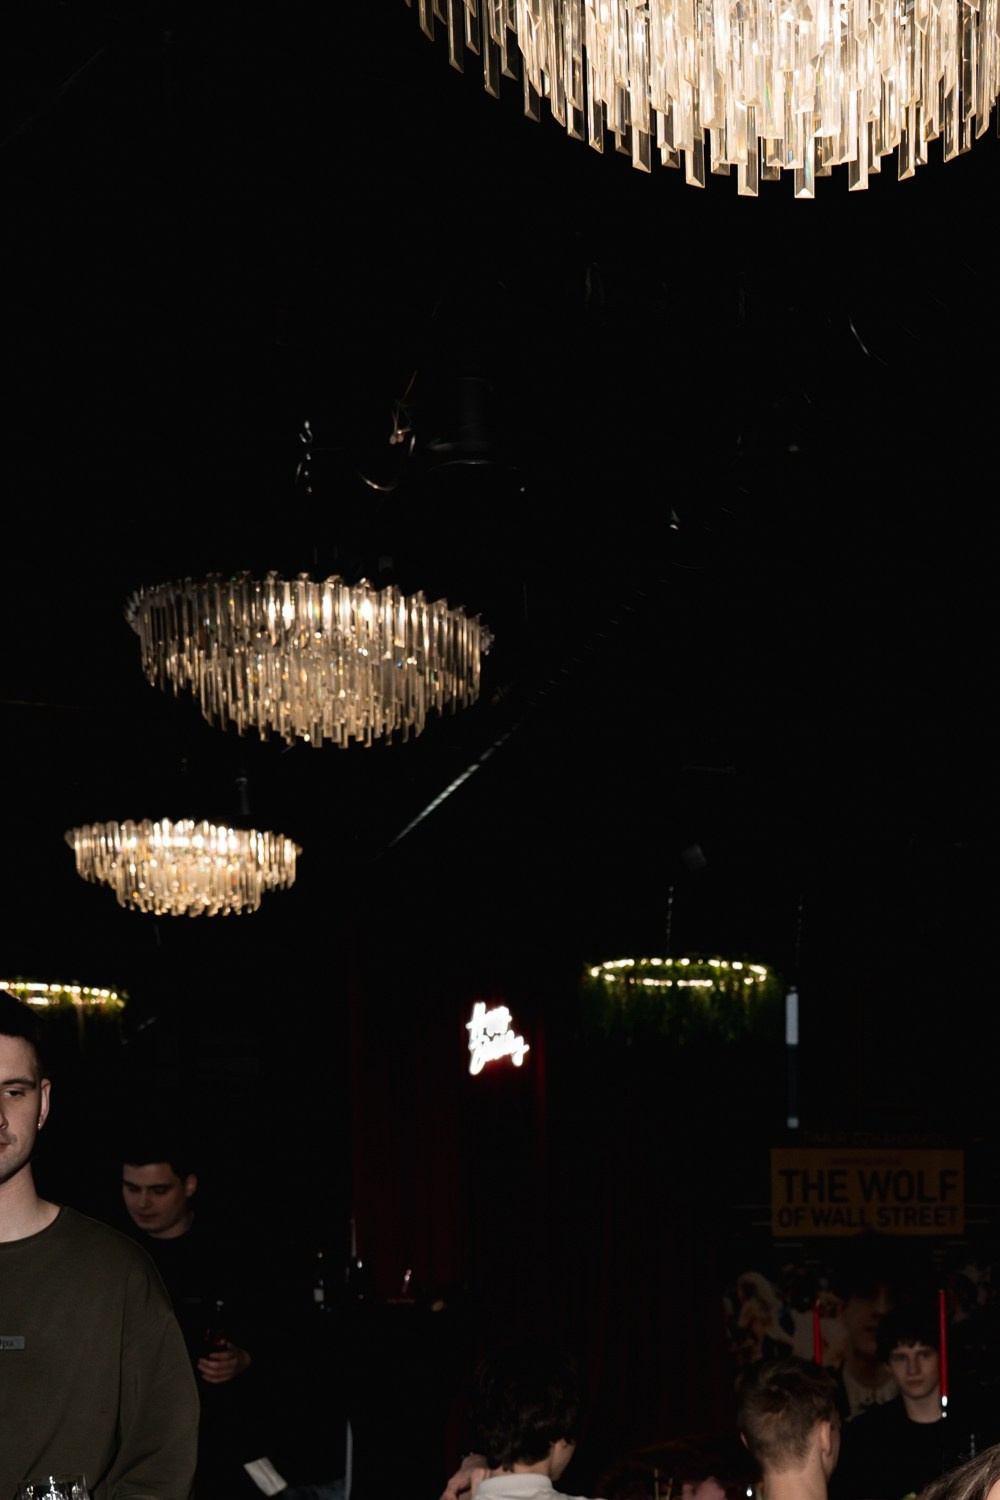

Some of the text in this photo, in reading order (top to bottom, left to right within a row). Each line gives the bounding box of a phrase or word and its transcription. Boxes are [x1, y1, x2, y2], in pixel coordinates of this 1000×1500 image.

[779, 1169, 958, 1203] THE WOLF
[778, 1206, 958, 1228] OF WALL STREET
